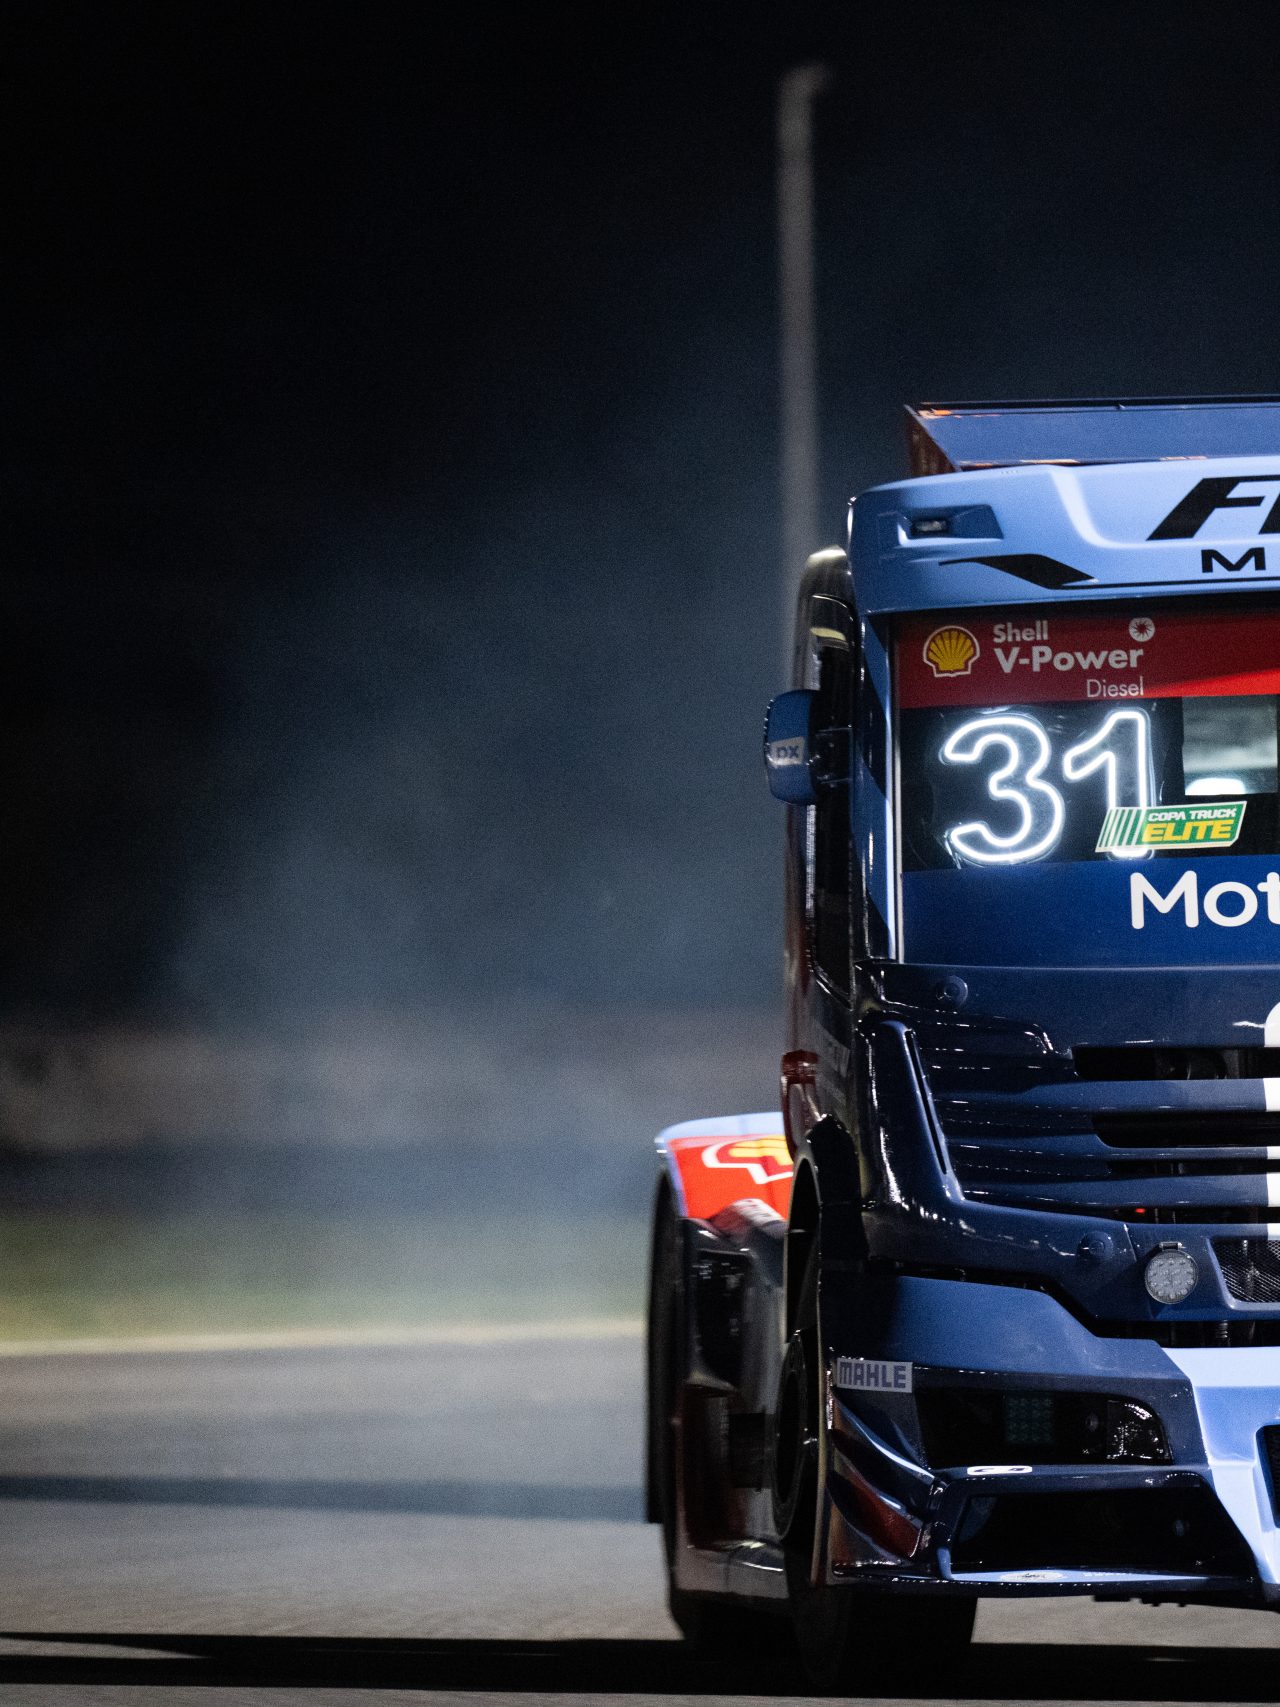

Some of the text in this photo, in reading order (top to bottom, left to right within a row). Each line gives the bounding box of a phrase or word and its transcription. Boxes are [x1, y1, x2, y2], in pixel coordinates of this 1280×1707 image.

[993, 620, 1049, 642] Shell
[993, 644, 1144, 673] V-Power
[1086, 677, 1144, 699] Diesel
[943, 711, 1153, 860] 31
[1148, 808, 1237, 822] COPA TRUCK
[1142, 819, 1234, 843] ELITE
[839, 1361, 907, 1389] MAHLE
